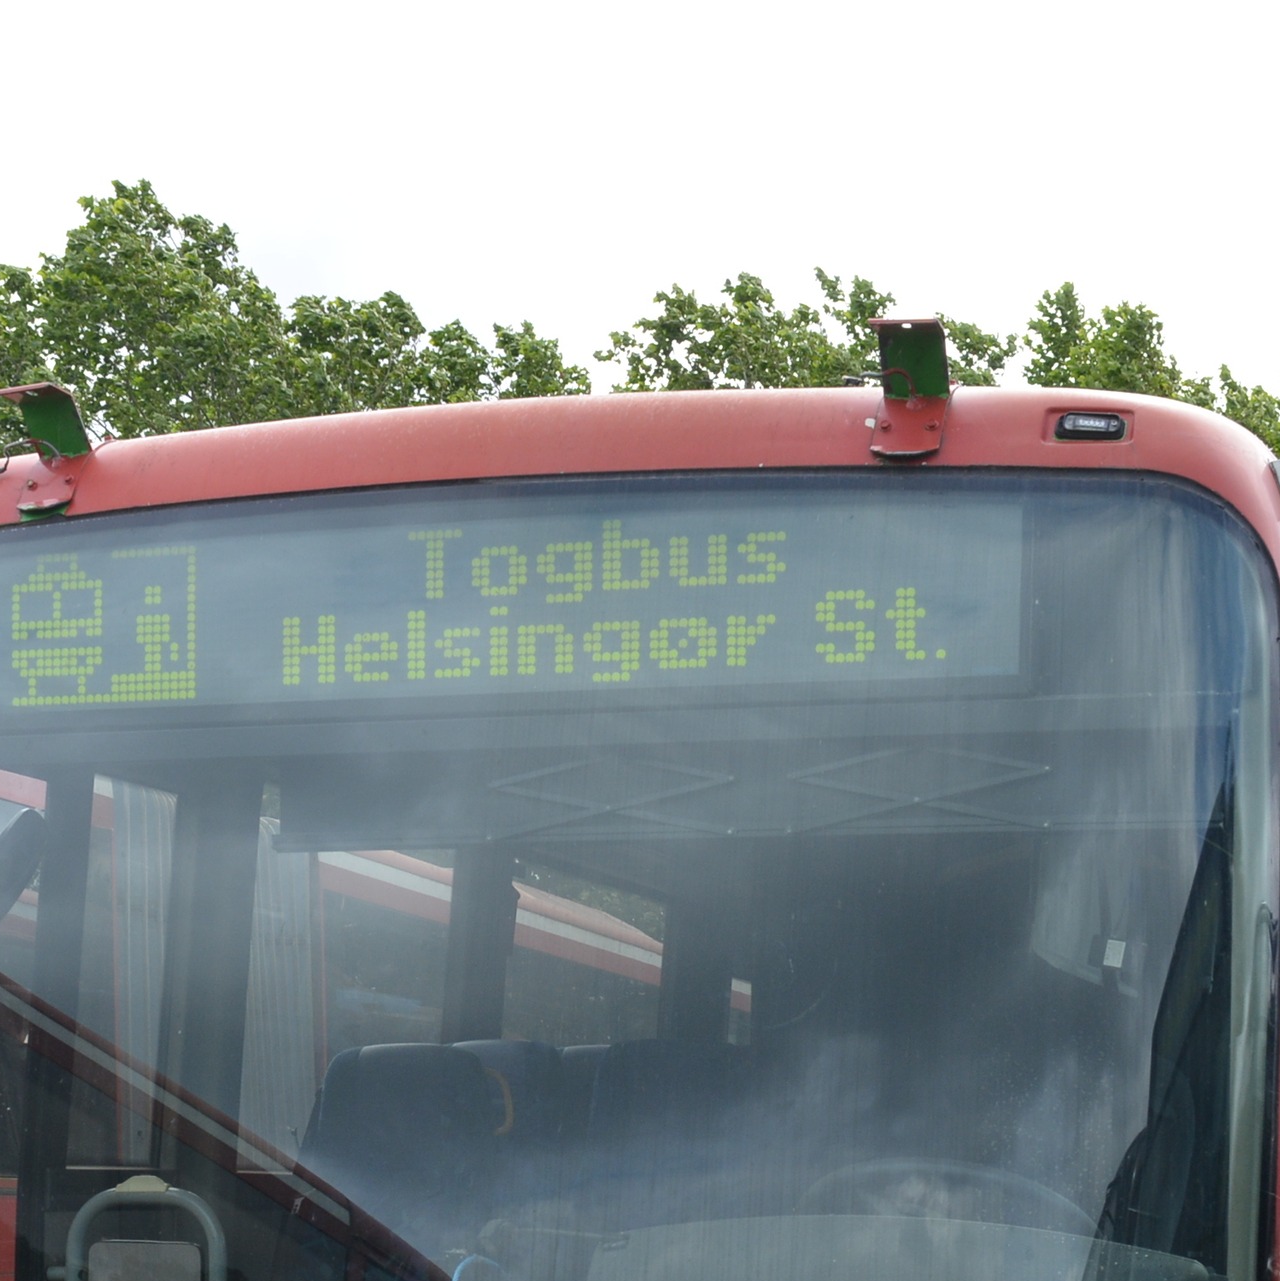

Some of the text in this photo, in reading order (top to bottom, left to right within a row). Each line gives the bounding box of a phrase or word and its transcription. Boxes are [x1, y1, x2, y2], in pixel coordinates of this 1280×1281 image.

[407, 520, 787, 604] Togbus
[282, 587, 947, 685] Helsingør St.
